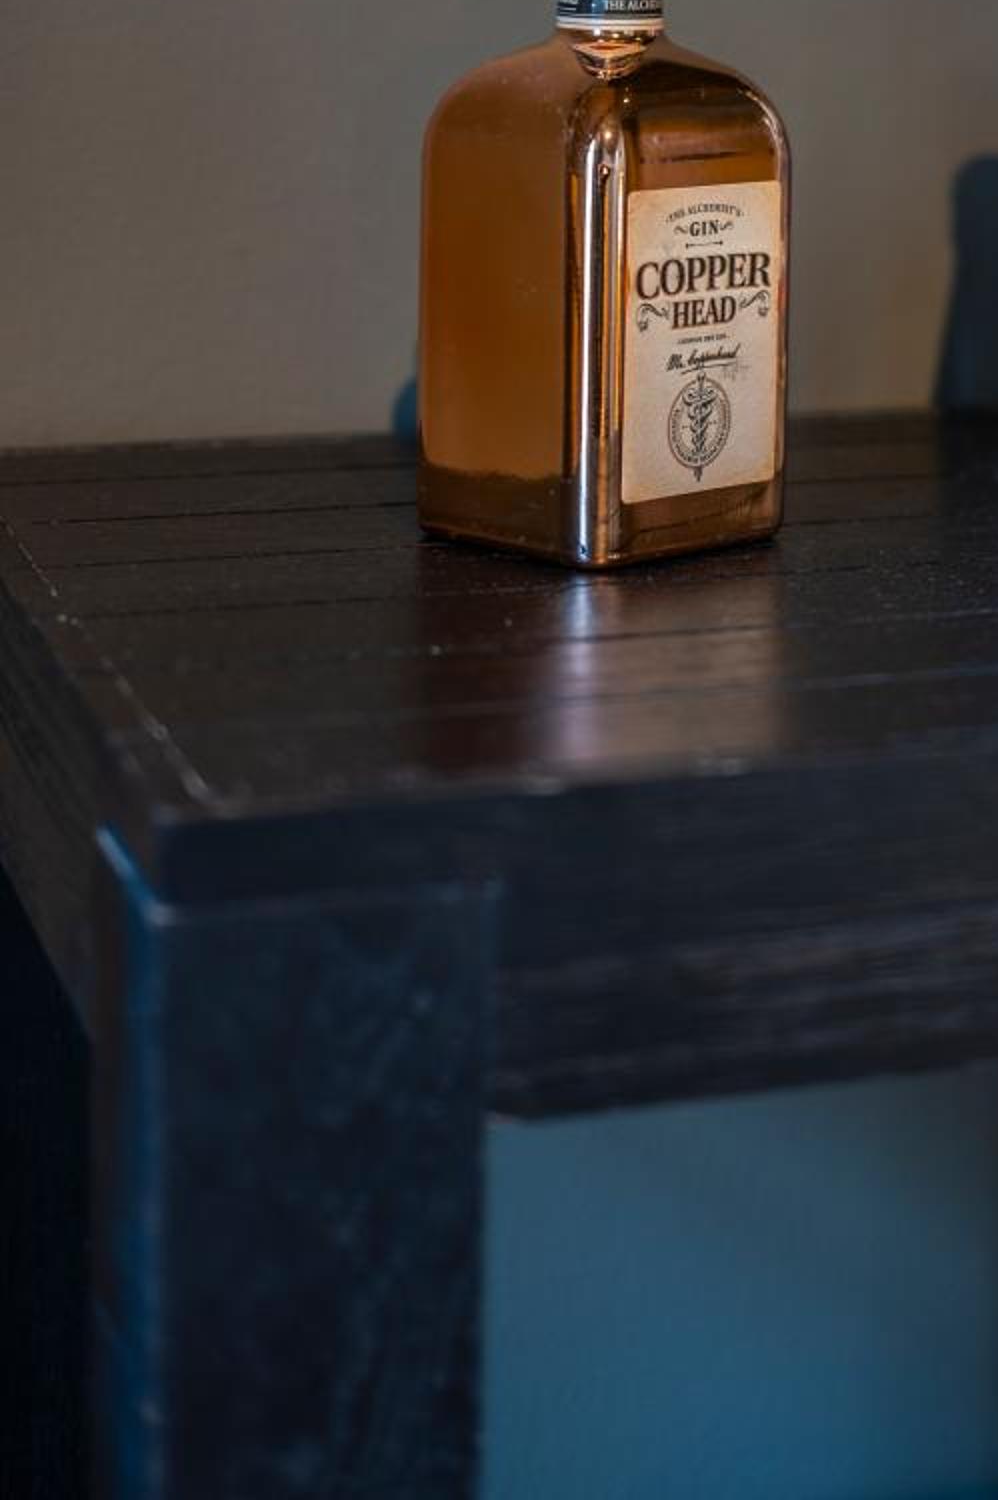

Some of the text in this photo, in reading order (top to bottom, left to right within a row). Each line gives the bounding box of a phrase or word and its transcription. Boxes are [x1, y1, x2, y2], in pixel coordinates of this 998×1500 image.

[603, 0, 626, 11] THE
[689, 219, 719, 237] GIN
[636, 252, 770, 301] COPPER
[672, 295, 737, 330] HEAD
